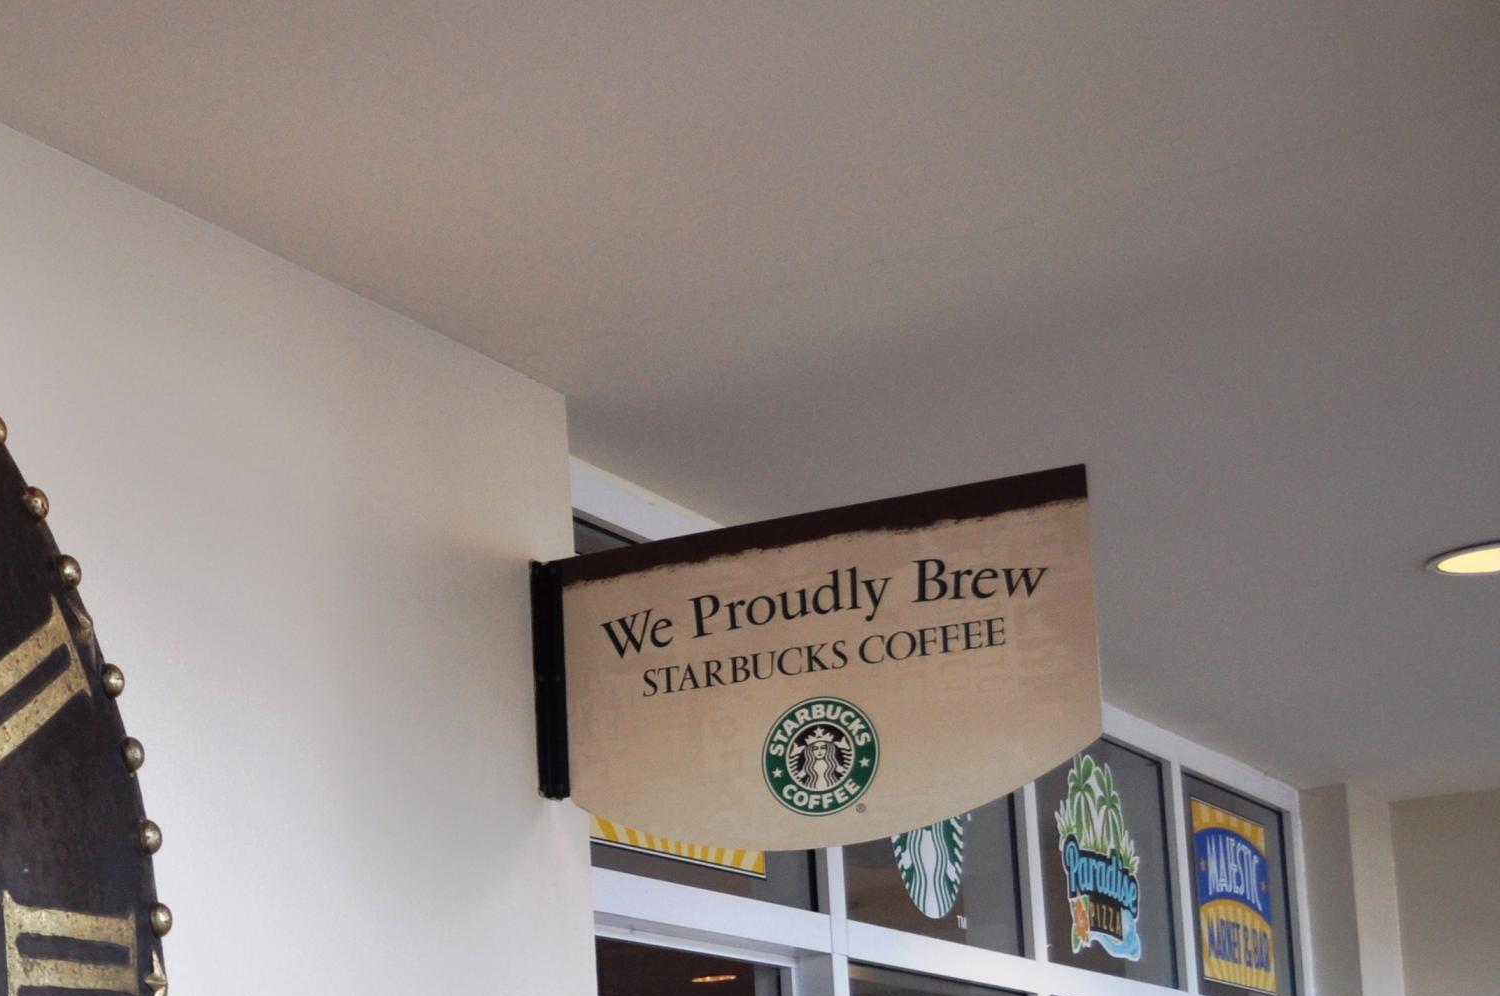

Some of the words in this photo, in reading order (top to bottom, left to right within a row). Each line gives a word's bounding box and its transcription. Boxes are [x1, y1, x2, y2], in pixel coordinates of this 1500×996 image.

[600, 608, 674, 659] We
[688, 566, 893, 639] Proudly
[911, 558, 1049, 603] Brew
[642, 639, 849, 698] STARBUCKS
[858, 616, 1007, 665] COFFEE
[768, 703, 872, 758] STARBUCKS
[781, 778, 861, 810] COFFEE
[1065, 840, 1138, 914] Paradise
[1206, 833, 1263, 913] MAJESTIC
[1090, 901, 1122, 935] PIZZA
[1207, 916, 1241, 965] MARKET
[1252, 928, 1271, 973] BAR
